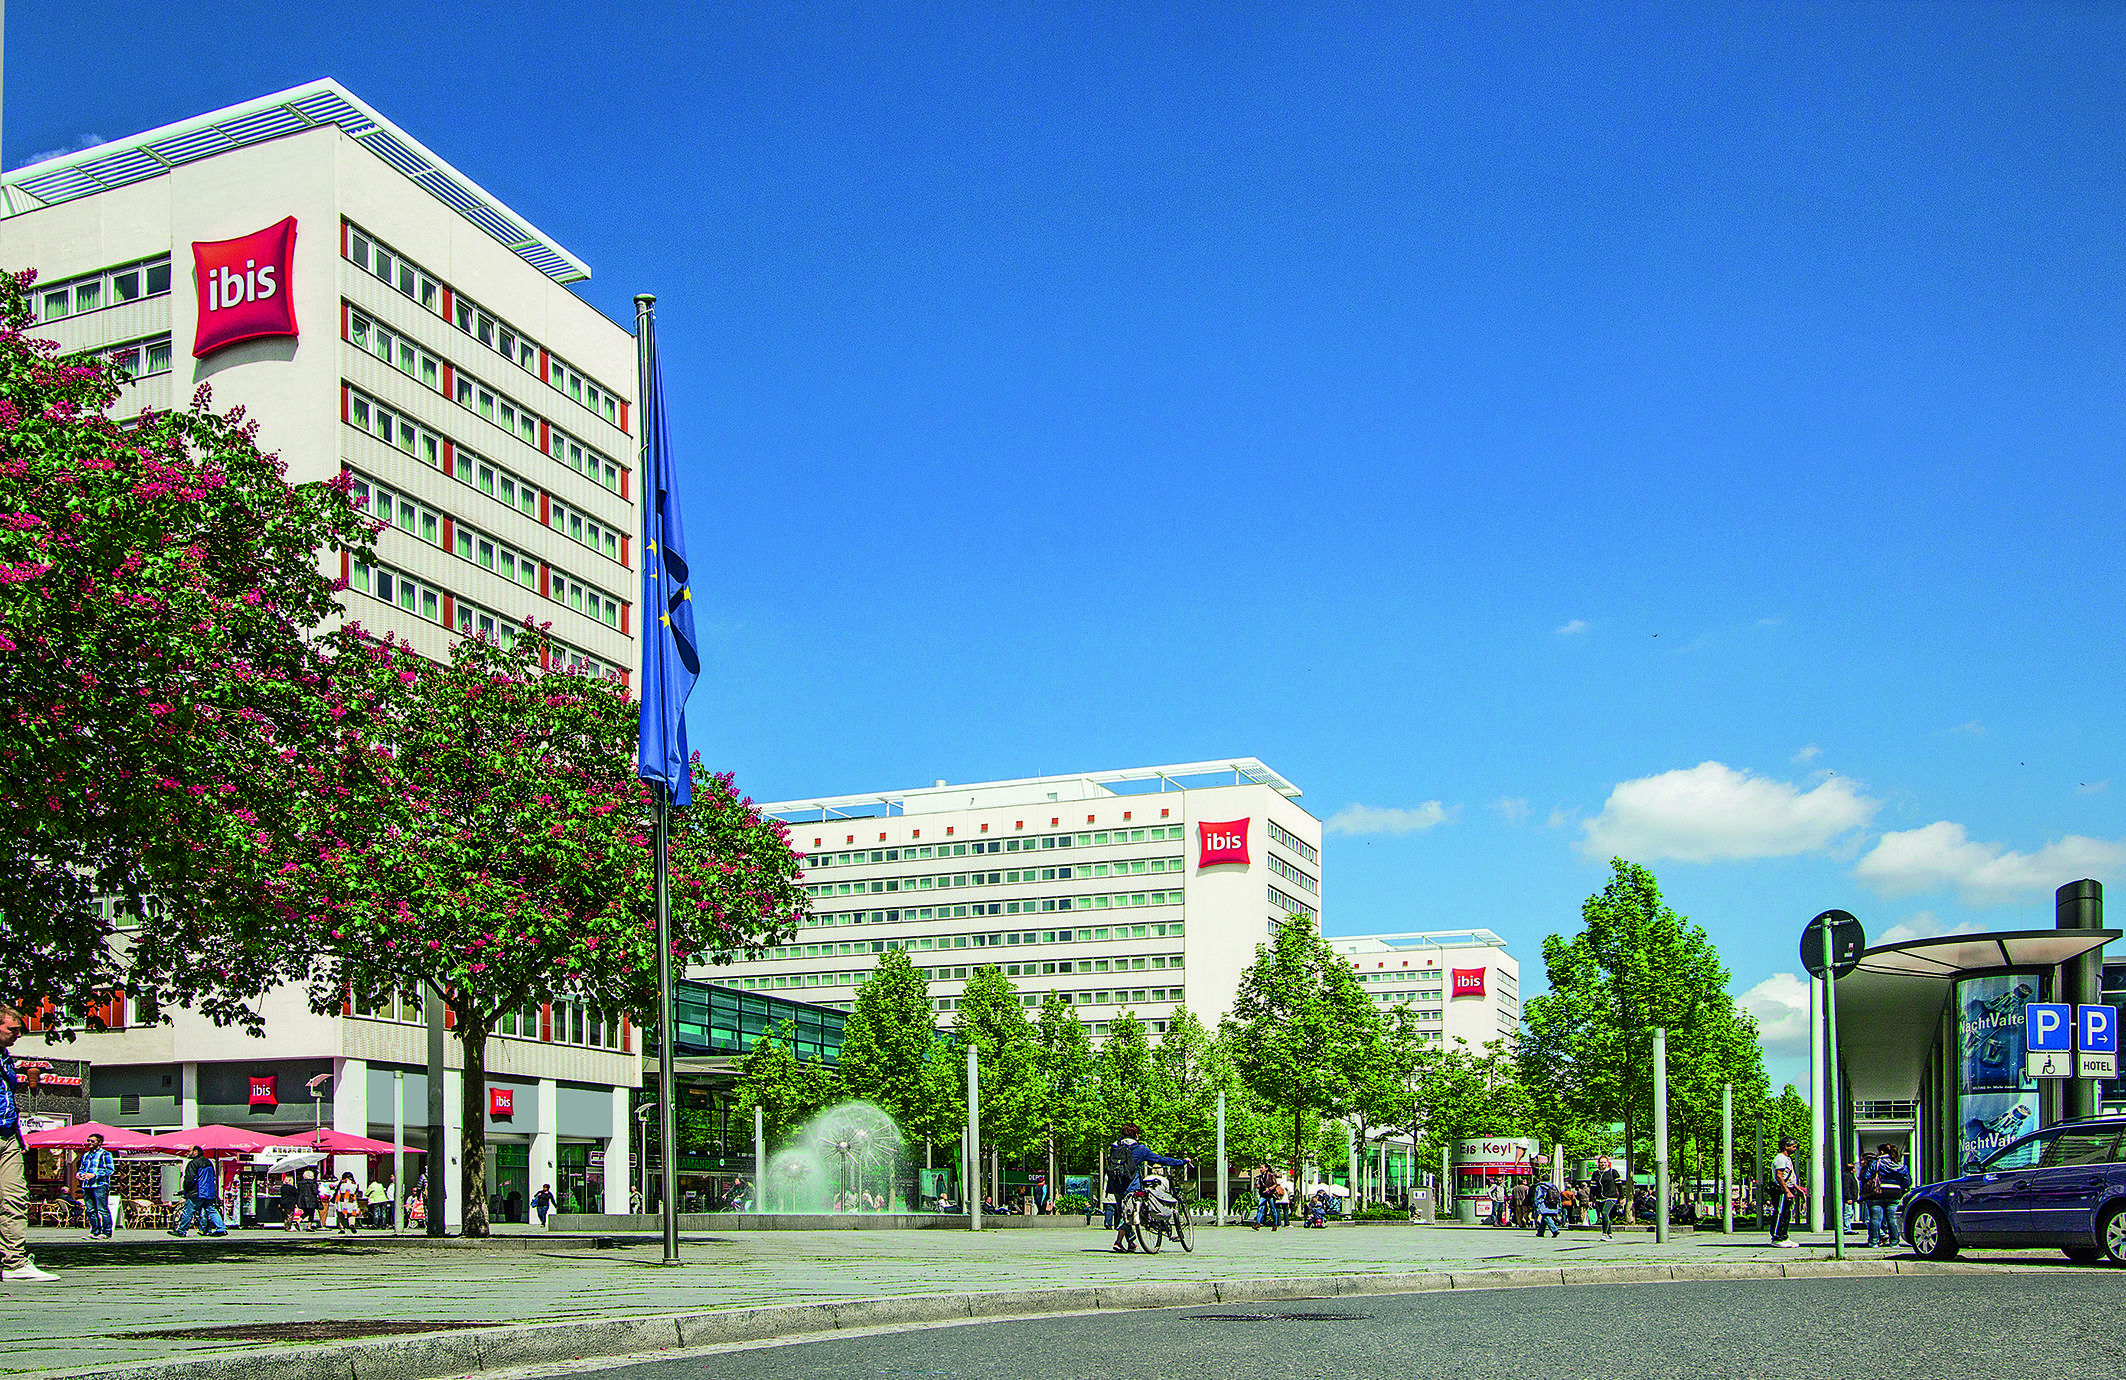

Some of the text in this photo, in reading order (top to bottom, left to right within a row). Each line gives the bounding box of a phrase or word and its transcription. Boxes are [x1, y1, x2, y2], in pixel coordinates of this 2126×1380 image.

[208, 259, 277, 312] ibis
[1207, 831, 1242, 851] ibis
[1457, 975, 1481, 988] ibis
[1959, 1012, 2025, 1035] NachtValte
[2036, 1009, 2060, 1045] P
[2087, 1011, 2107, 1046] P
[2083, 1061, 2113, 1072] HOTEL
[43, 1074, 82, 1086] Pizza
[252, 1084, 271, 1097] ibis
[496, 1095, 511, 1108] ibis
[1459, 1142, 1511, 1157] Eis Keyl
[1959, 1132, 2017, 1152] NachtValt
